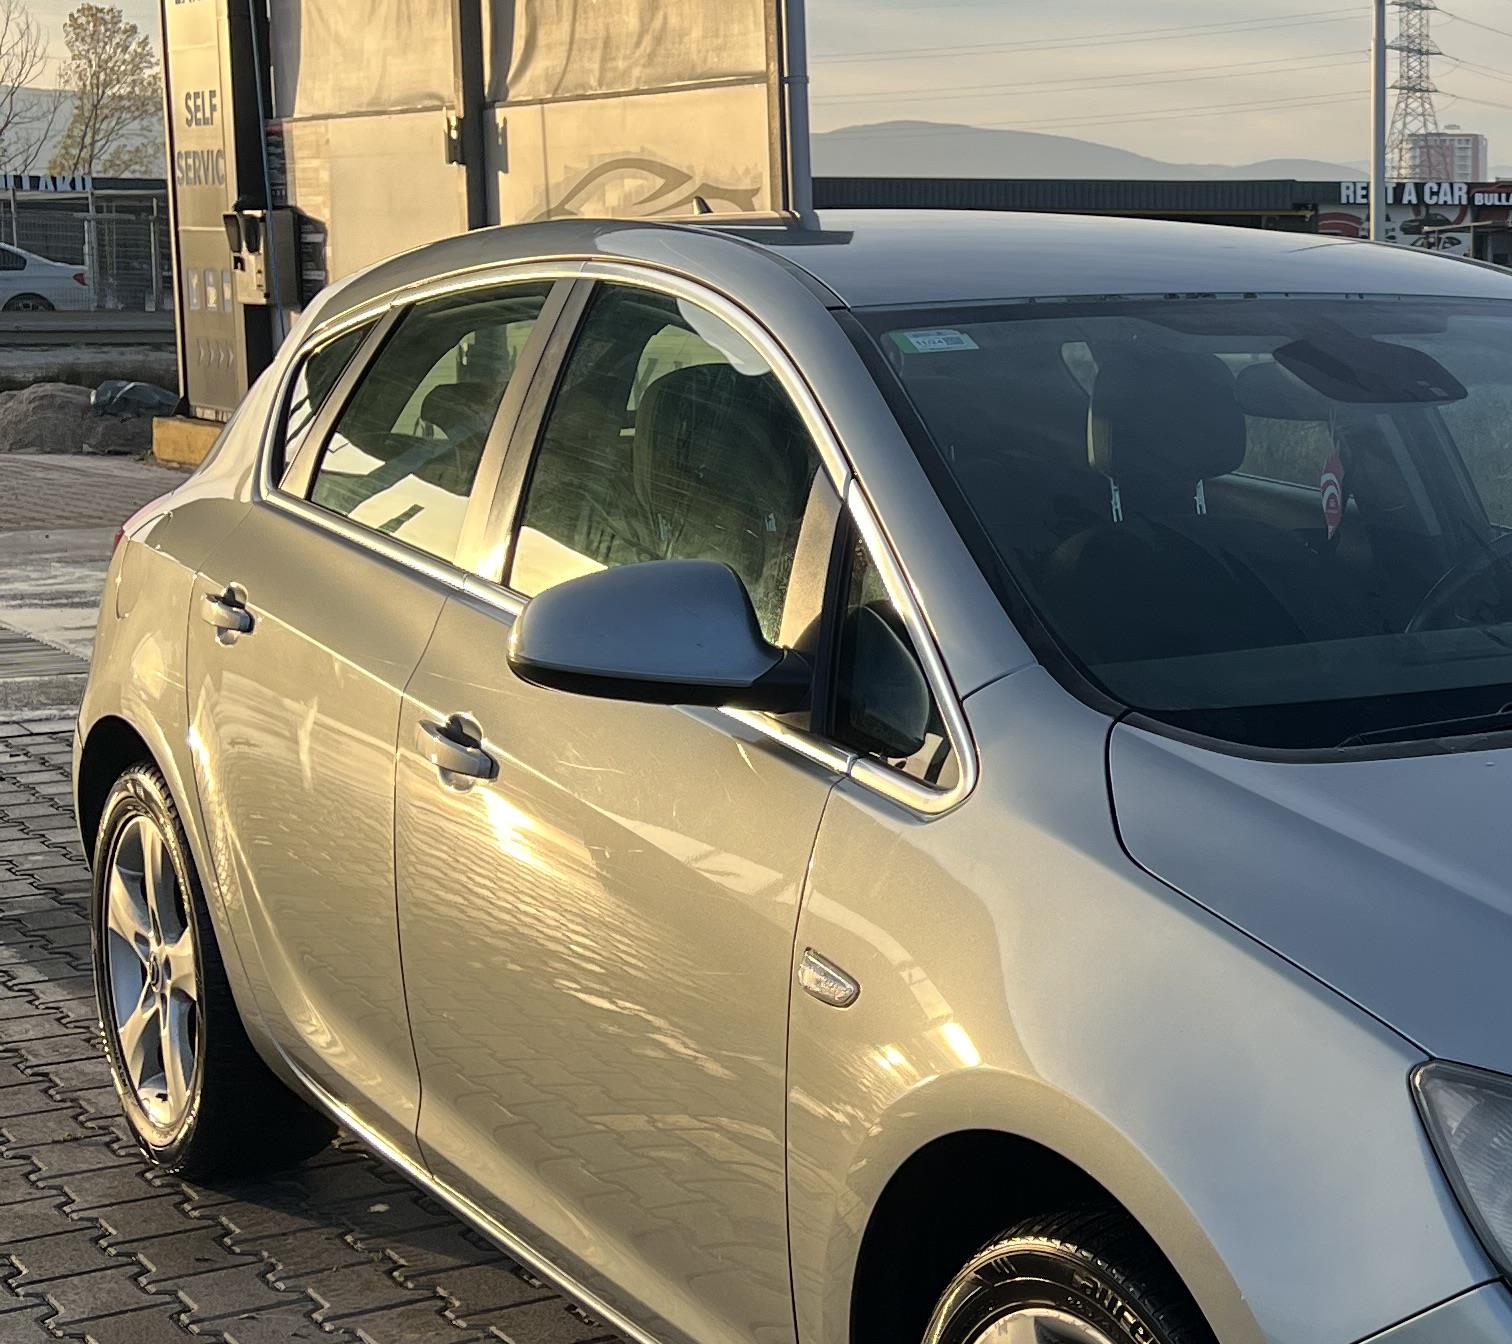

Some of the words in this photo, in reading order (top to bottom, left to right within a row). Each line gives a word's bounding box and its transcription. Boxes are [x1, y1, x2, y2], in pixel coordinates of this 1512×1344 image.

[185, 90, 217, 128] SELF
[177, 149, 225, 187] SERVIC
[1340, 182, 1397, 205] RET
[1402, 182, 1417, 205] A
[1423, 182, 1468, 205] CAR
